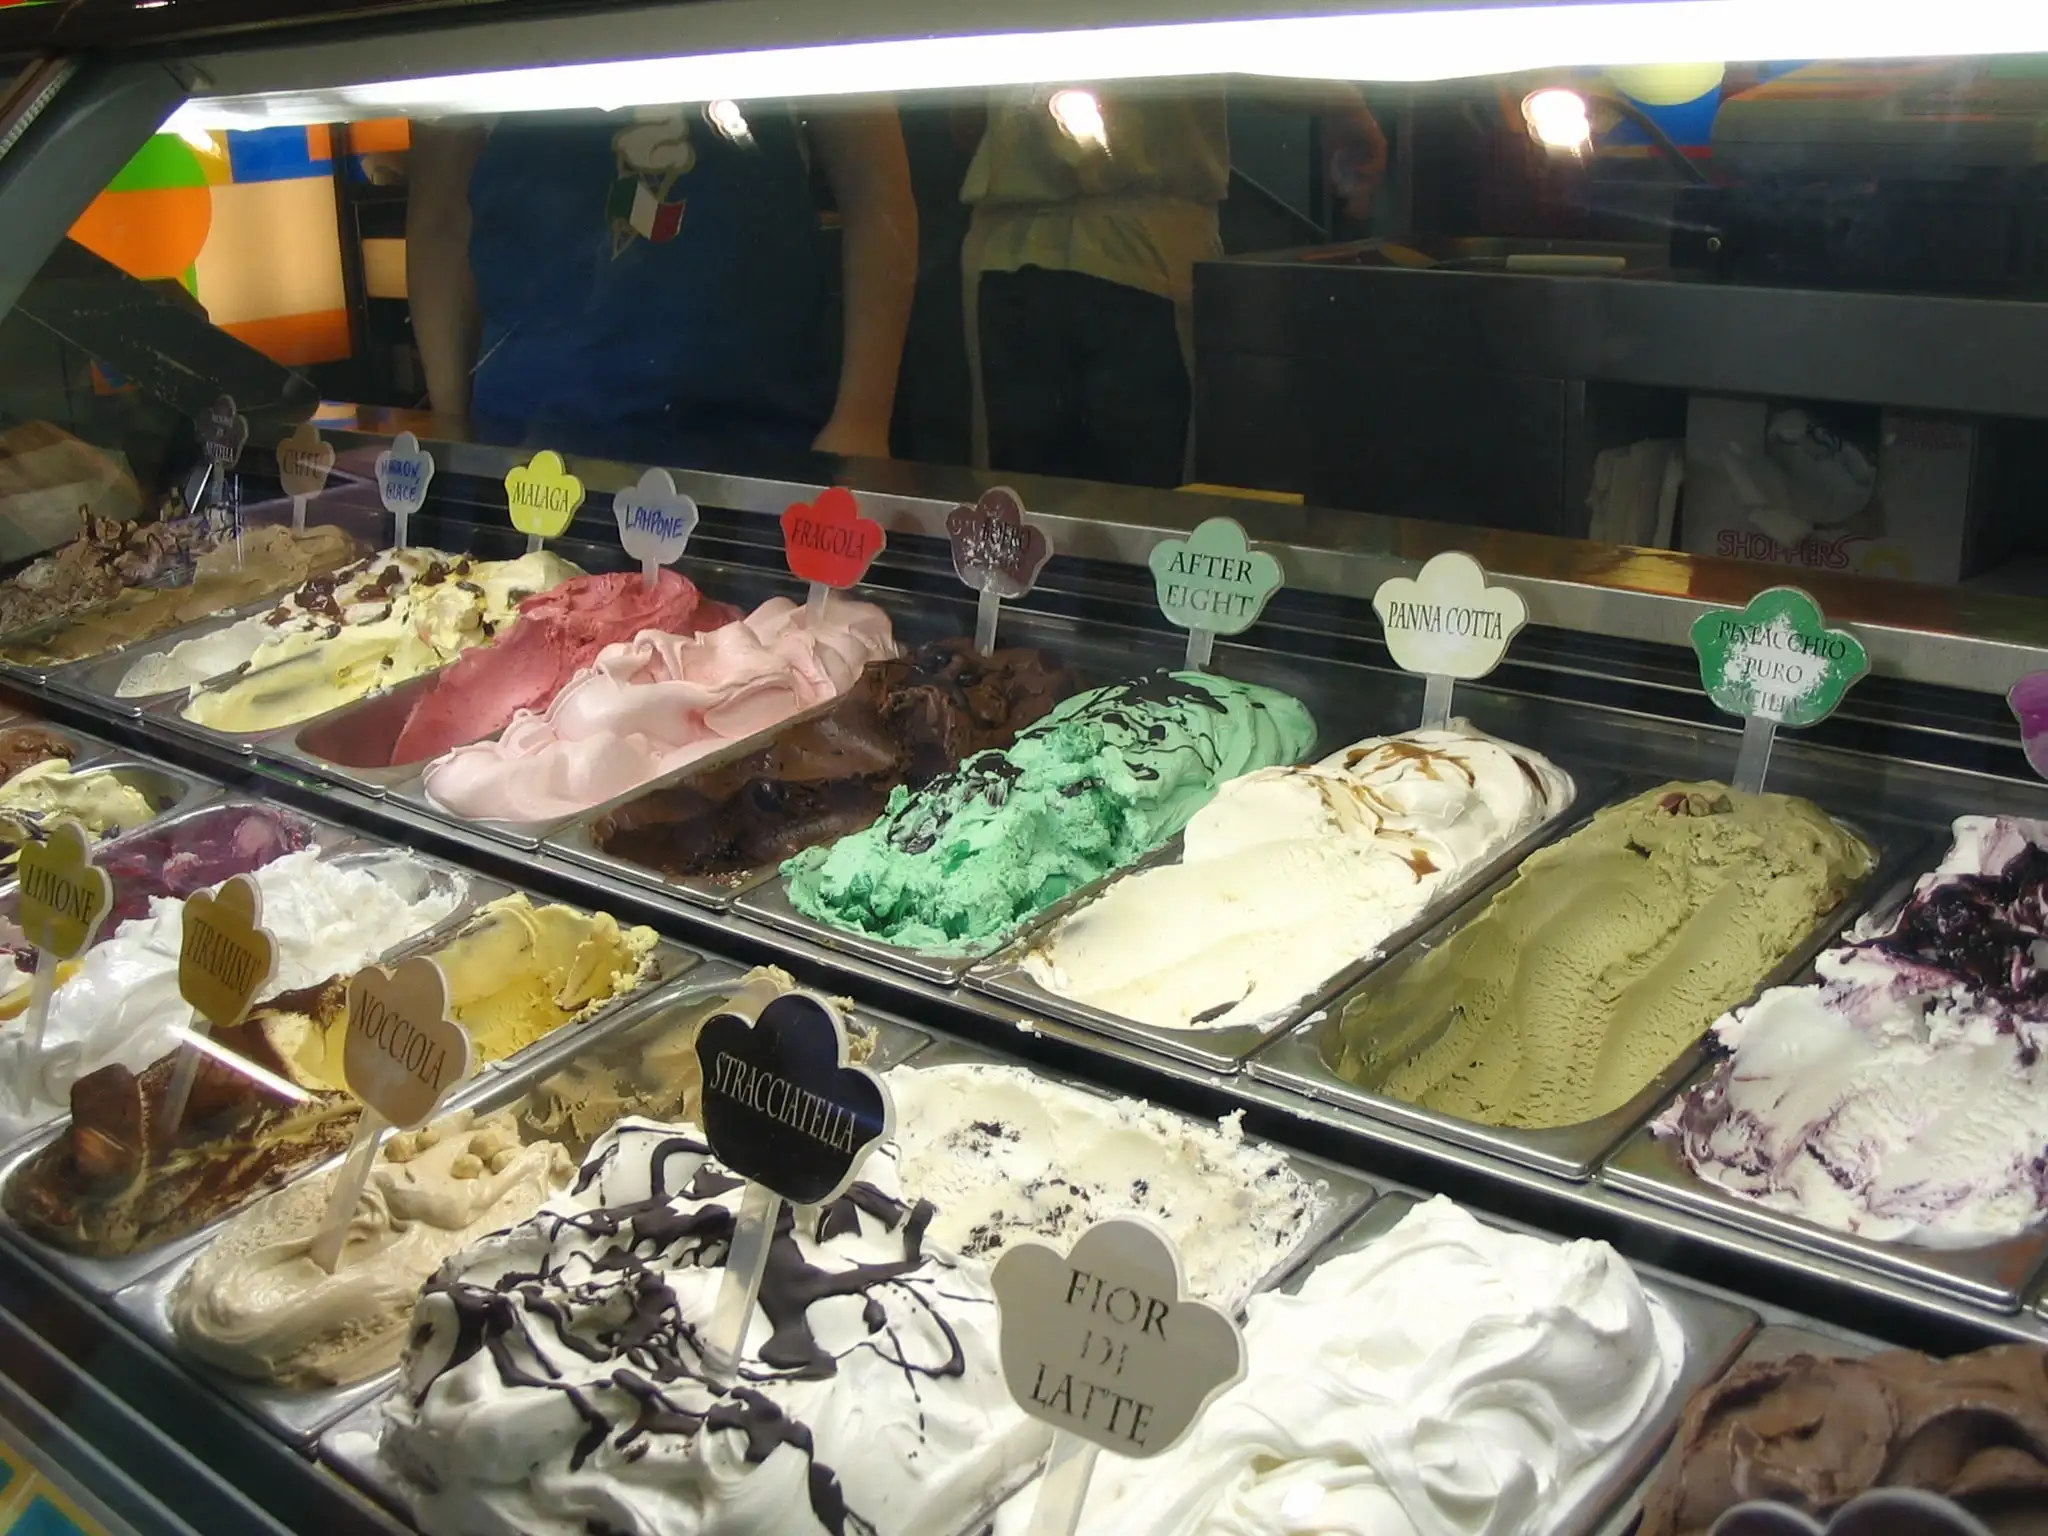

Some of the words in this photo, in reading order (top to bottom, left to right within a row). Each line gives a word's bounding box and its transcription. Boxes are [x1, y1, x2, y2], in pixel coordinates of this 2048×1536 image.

[512, 481, 568, 513] MALAGA
[625, 504, 684, 543] LAMPONE
[791, 516, 865, 560] FRAGOLA
[1168, 551, 1253, 585] AFTER
[1716, 530, 1850, 569] SHOPPERS
[1164, 584, 1253, 619] EIGHT
[1387, 601, 1443, 637] PANNA
[1445, 607, 1503, 640] COTTA
[1718, 620, 1847, 661] PISTACCHIO
[1743, 656, 1803, 684] PURO
[24, 863, 96, 926] LIMONE
[351, 988, 447, 1093] NOCCIOLA
[710, 1051, 858, 1155] STRACCIATELLA
[1064, 1268, 1170, 1342] FIOR
[1080, 1329, 1130, 1377] DI
[1028, 1360, 1154, 1449] LATTE
